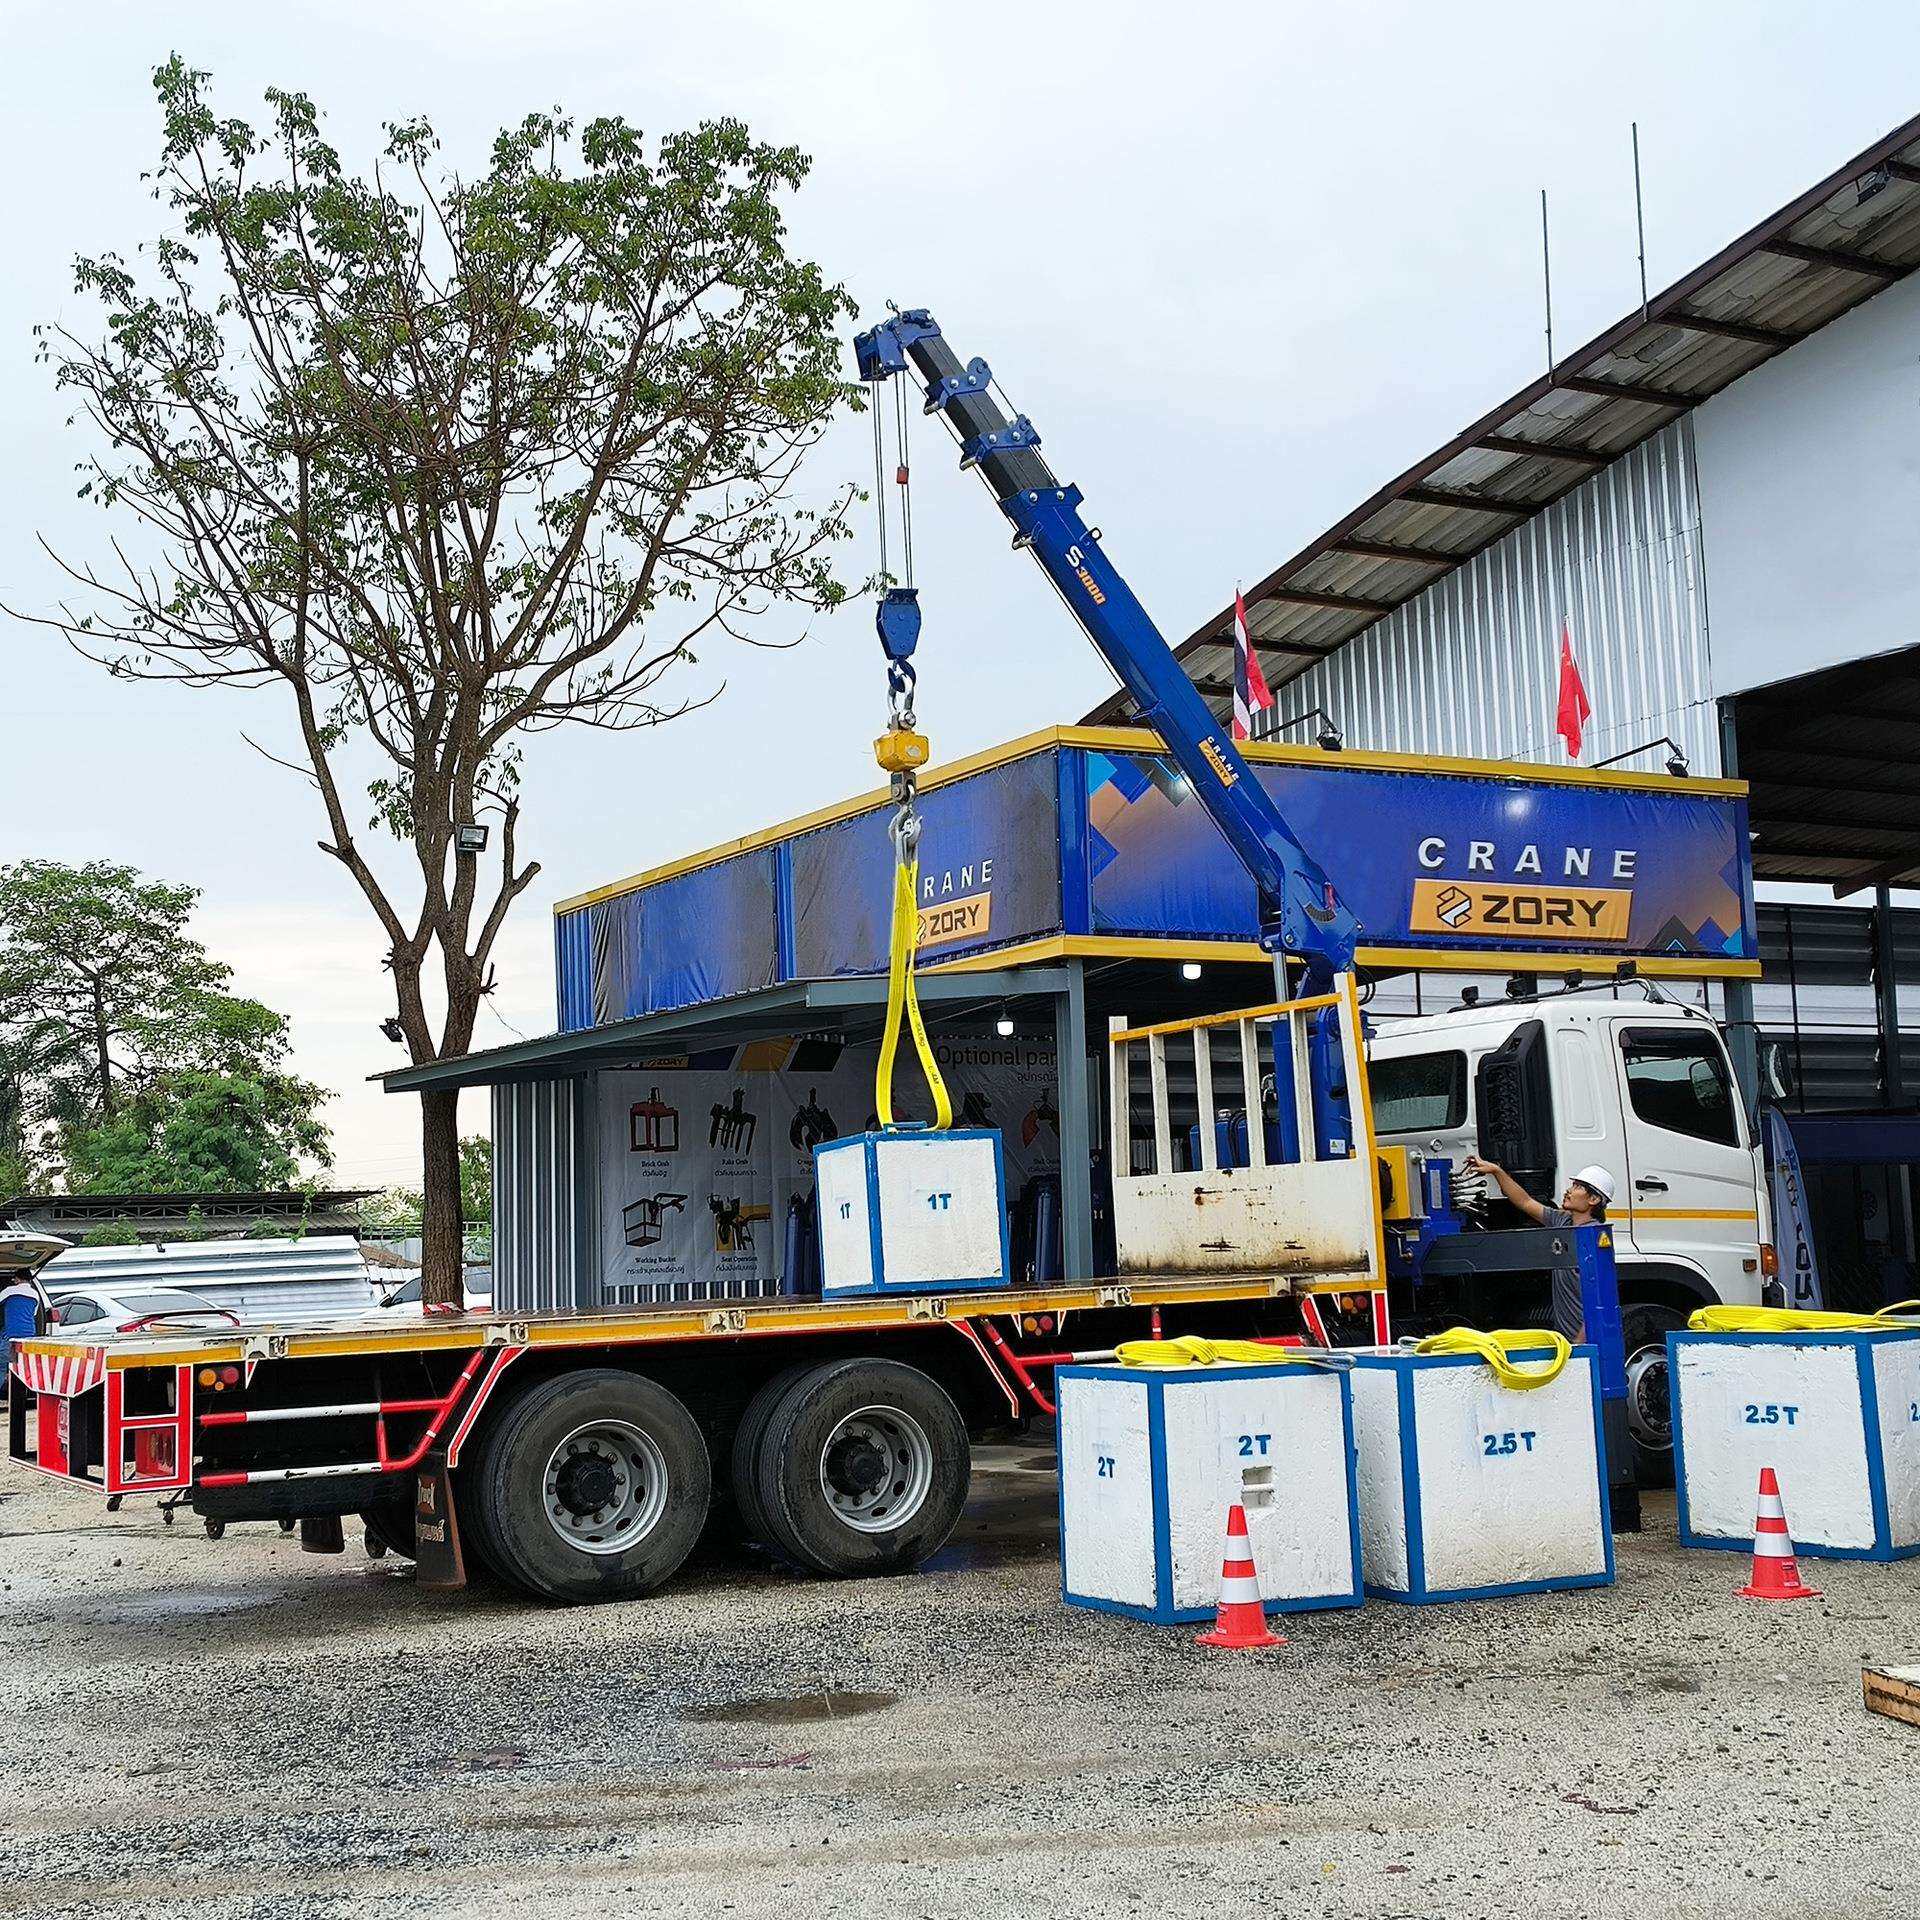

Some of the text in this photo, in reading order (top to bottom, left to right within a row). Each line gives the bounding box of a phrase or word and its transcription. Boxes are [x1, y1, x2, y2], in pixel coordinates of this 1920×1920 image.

[1207, 736, 1239, 780] CRANE
[1417, 837, 1638, 879] CRANE
[924, 859, 993, 898] RANE
[930, 903, 980, 936] ZORY
[1481, 894, 1608, 928] ZORY
[937, 1045, 1058, 1071] Optional par
[840, 1202, 851, 1219] 1T
[927, 1193, 952, 1210] 1T
[1745, 1404, 1799, 1425] 2.5T
[1238, 1434, 1272, 1456] 2T
[1483, 1431, 1536, 1456] 2.5T
[1098, 1456, 1115, 1478] 2T
